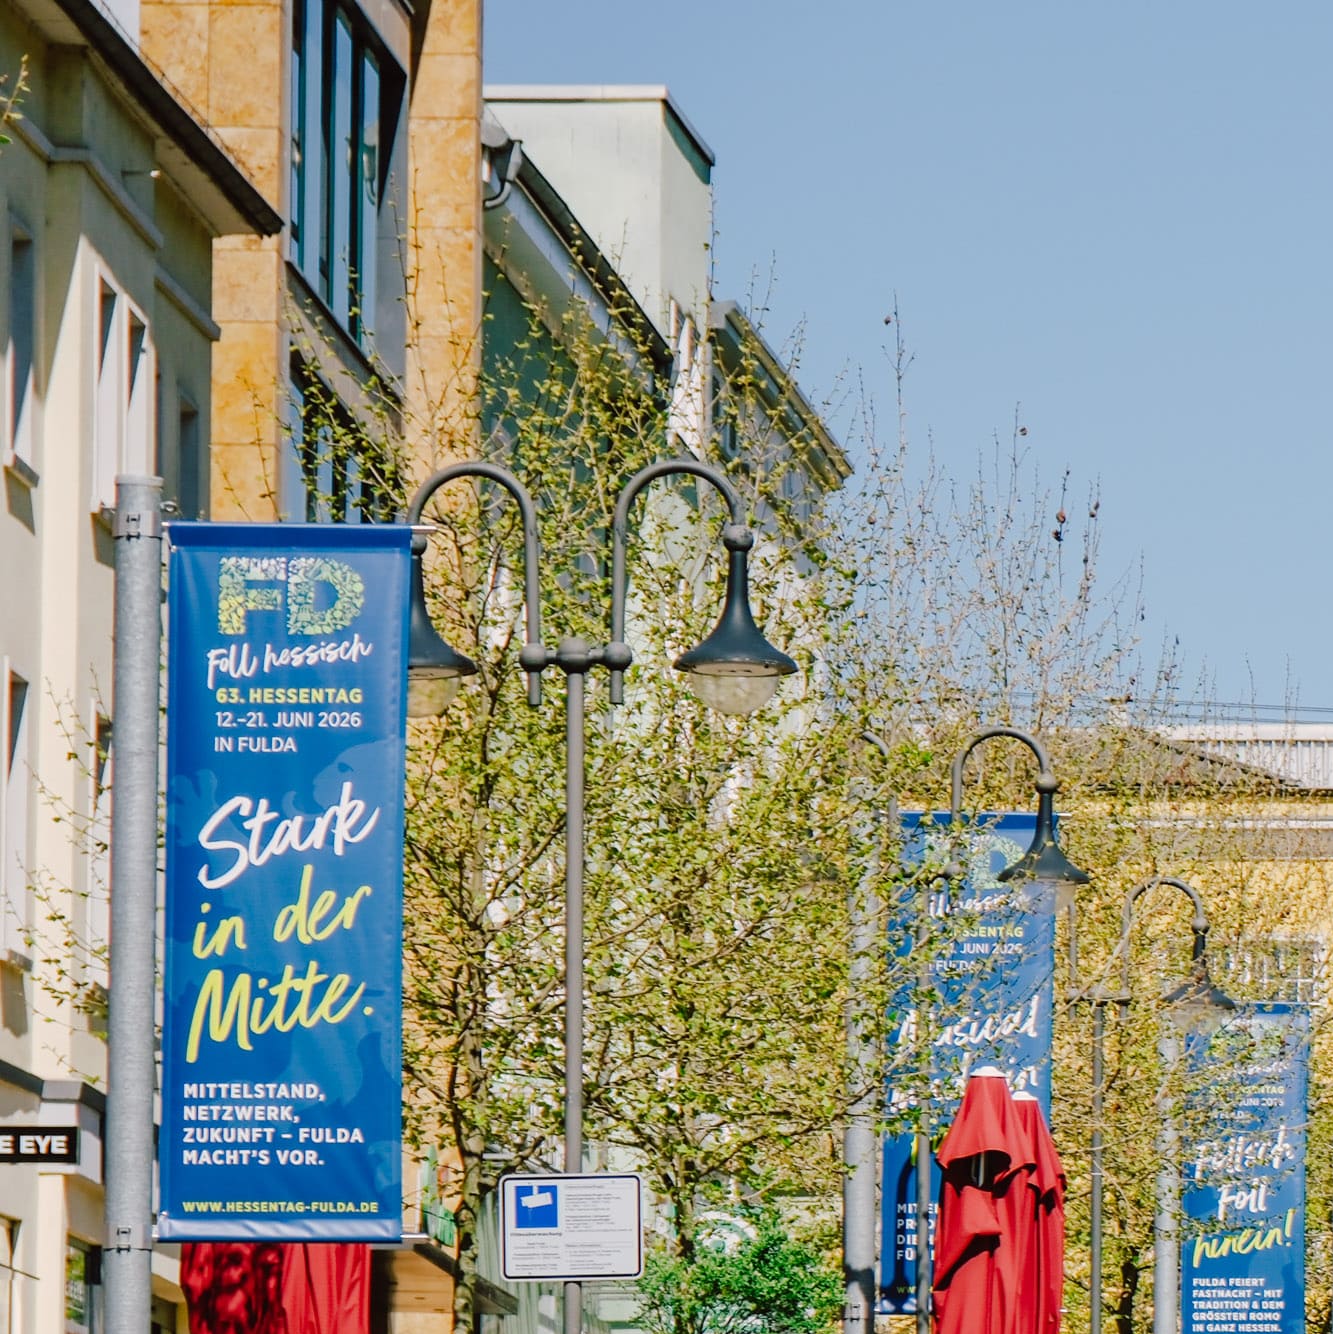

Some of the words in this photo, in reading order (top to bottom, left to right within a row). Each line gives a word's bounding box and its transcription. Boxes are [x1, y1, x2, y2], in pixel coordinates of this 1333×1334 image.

[218, 557, 364, 634] FD
[207, 643, 257, 689] Foll
[263, 633, 372, 672] hessisch
[216, 688, 245, 703] 63.
[249, 688, 362, 703] HESSENTAG
[272, 711, 313, 727] JUNI
[318, 711, 362, 727] 2026
[214, 737, 232, 752] IN
[238, 737, 297, 752] FULDA
[197, 781, 380, 889] Stark
[192, 902, 247, 959] in
[273, 864, 372, 945] der
[186, 960, 374, 1064] Mitte.
[183, 1083, 325, 1101] MITTELSTAND,
[183, 1105, 300, 1123] NETZWERK,
[182, 1128, 275, 1143] ZUKUNFT
[299, 1128, 364, 1143] FULDA
[19, 1135, 68, 1154] EYE
[276, 1150, 325, 1165] VOR.
[1218, 1176, 1268, 1221] Foll
[182, 1202, 379, 1213] WWW.HESSENTAG-FULDA.DE
[1193, 1208, 1297, 1268] hinein!
[1192, 1278, 1226, 1287] FULDA
[1229, 1278, 1265, 1287] FEIERT
[1192, 1290, 1252, 1298] FASTNACHT
[1263, 1290, 1282, 1298] MIT
[1192, 1301, 1249, 1310] TRADITION
[1262, 1301, 1285, 1310] DEM
[1192, 1311, 1247, 1321] GRÖSSTEN
[1249, 1312, 1281, 1321] ROMO
[1192, 1324, 1204, 1333] IN
[1207, 1324, 1236, 1333] GANZ
[1238, 1324, 1282, 1333] HESSEN.
